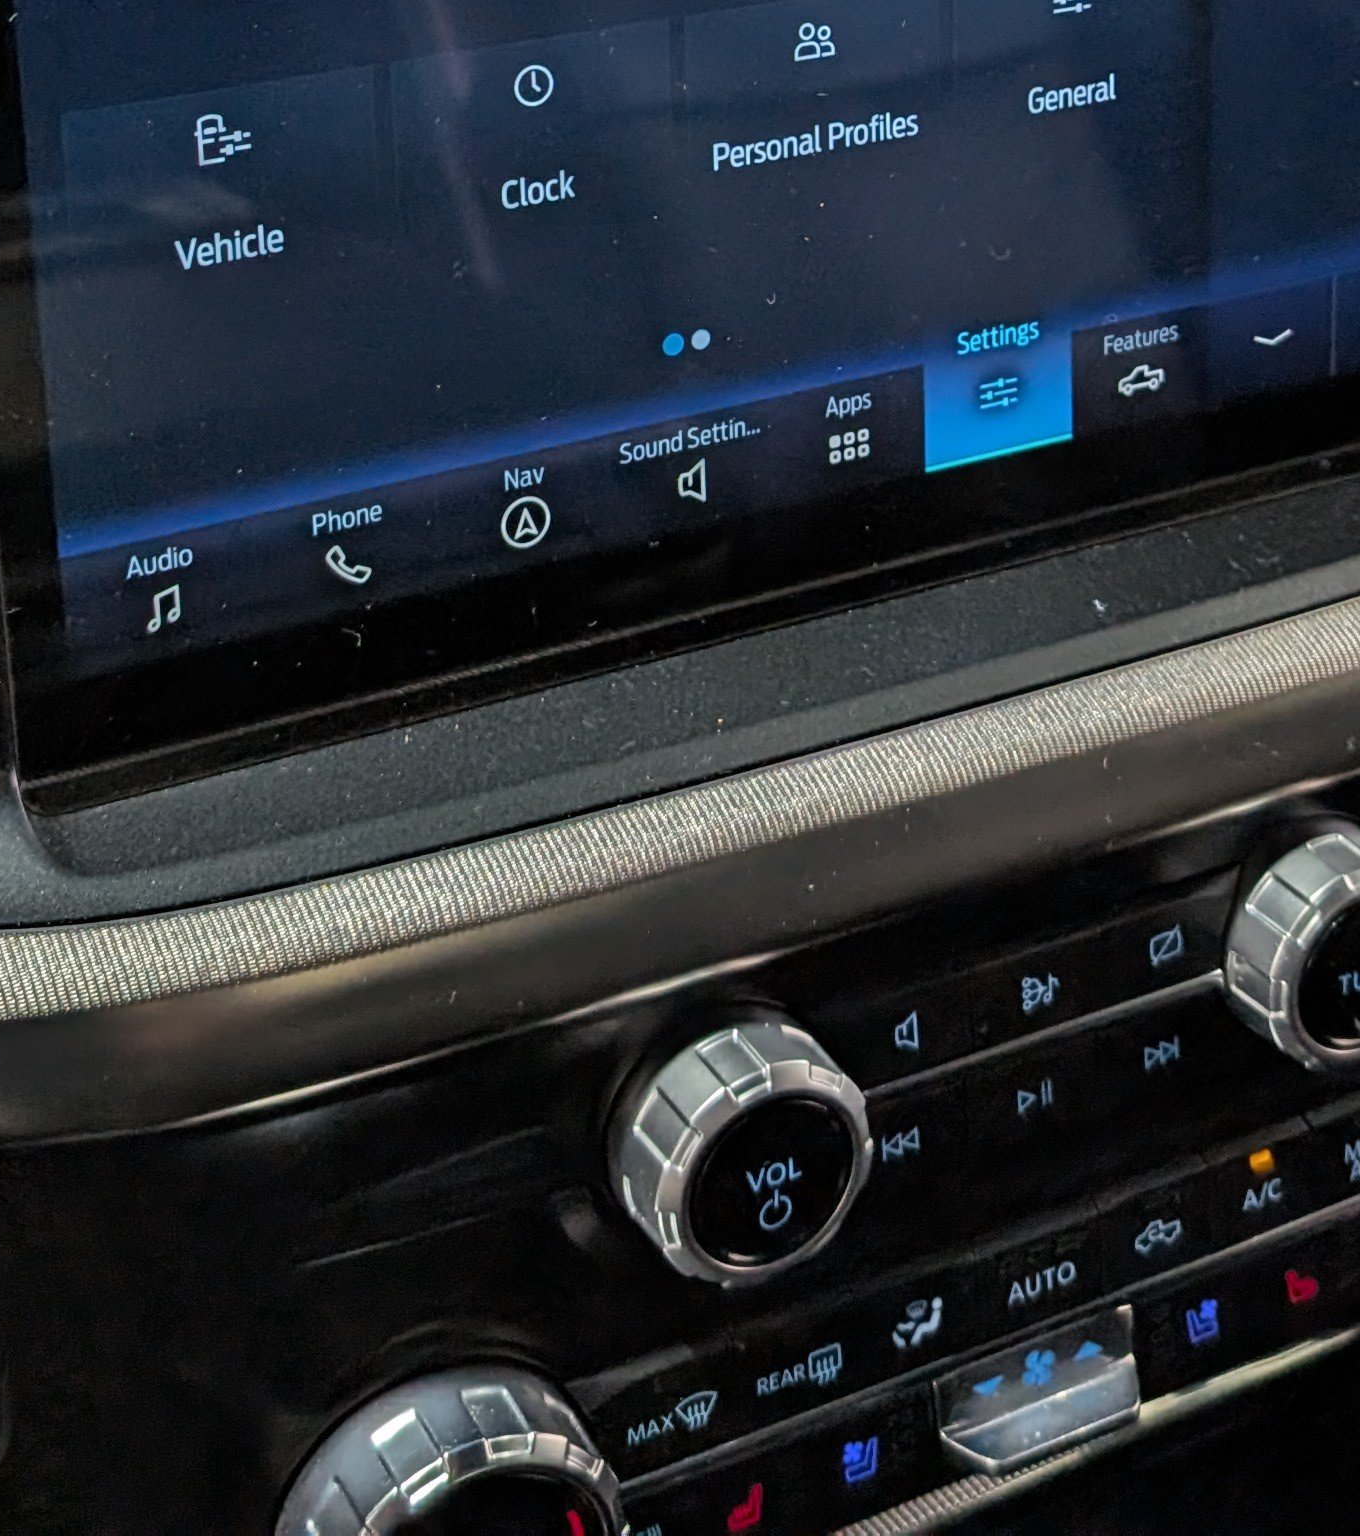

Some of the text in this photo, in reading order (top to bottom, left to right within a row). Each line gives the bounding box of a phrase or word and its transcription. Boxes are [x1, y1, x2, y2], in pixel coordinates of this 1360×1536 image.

[1027, 72, 1117, 114] General
[712, 112, 919, 172] Personal Profiles
[501, 169, 575, 210] Clock
[174, 224, 285, 270] Vehicle
[956, 319, 1041, 355] Settings
[1102, 322, 1180, 355] Features
[825, 390, 872, 418] Apps
[619, 431, 684, 465] Sound
[503, 466, 545, 491] Nav
[311, 504, 383, 536] Phone
[126, 546, 194, 580] Audio
[746, 1157, 802, 1194] VOL
[1242, 1177, 1282, 1211] A/C
[1008, 1261, 1076, 1305] AUTO
[754, 1363, 806, 1398] REAR
[627, 1412, 675, 1445] MAX
